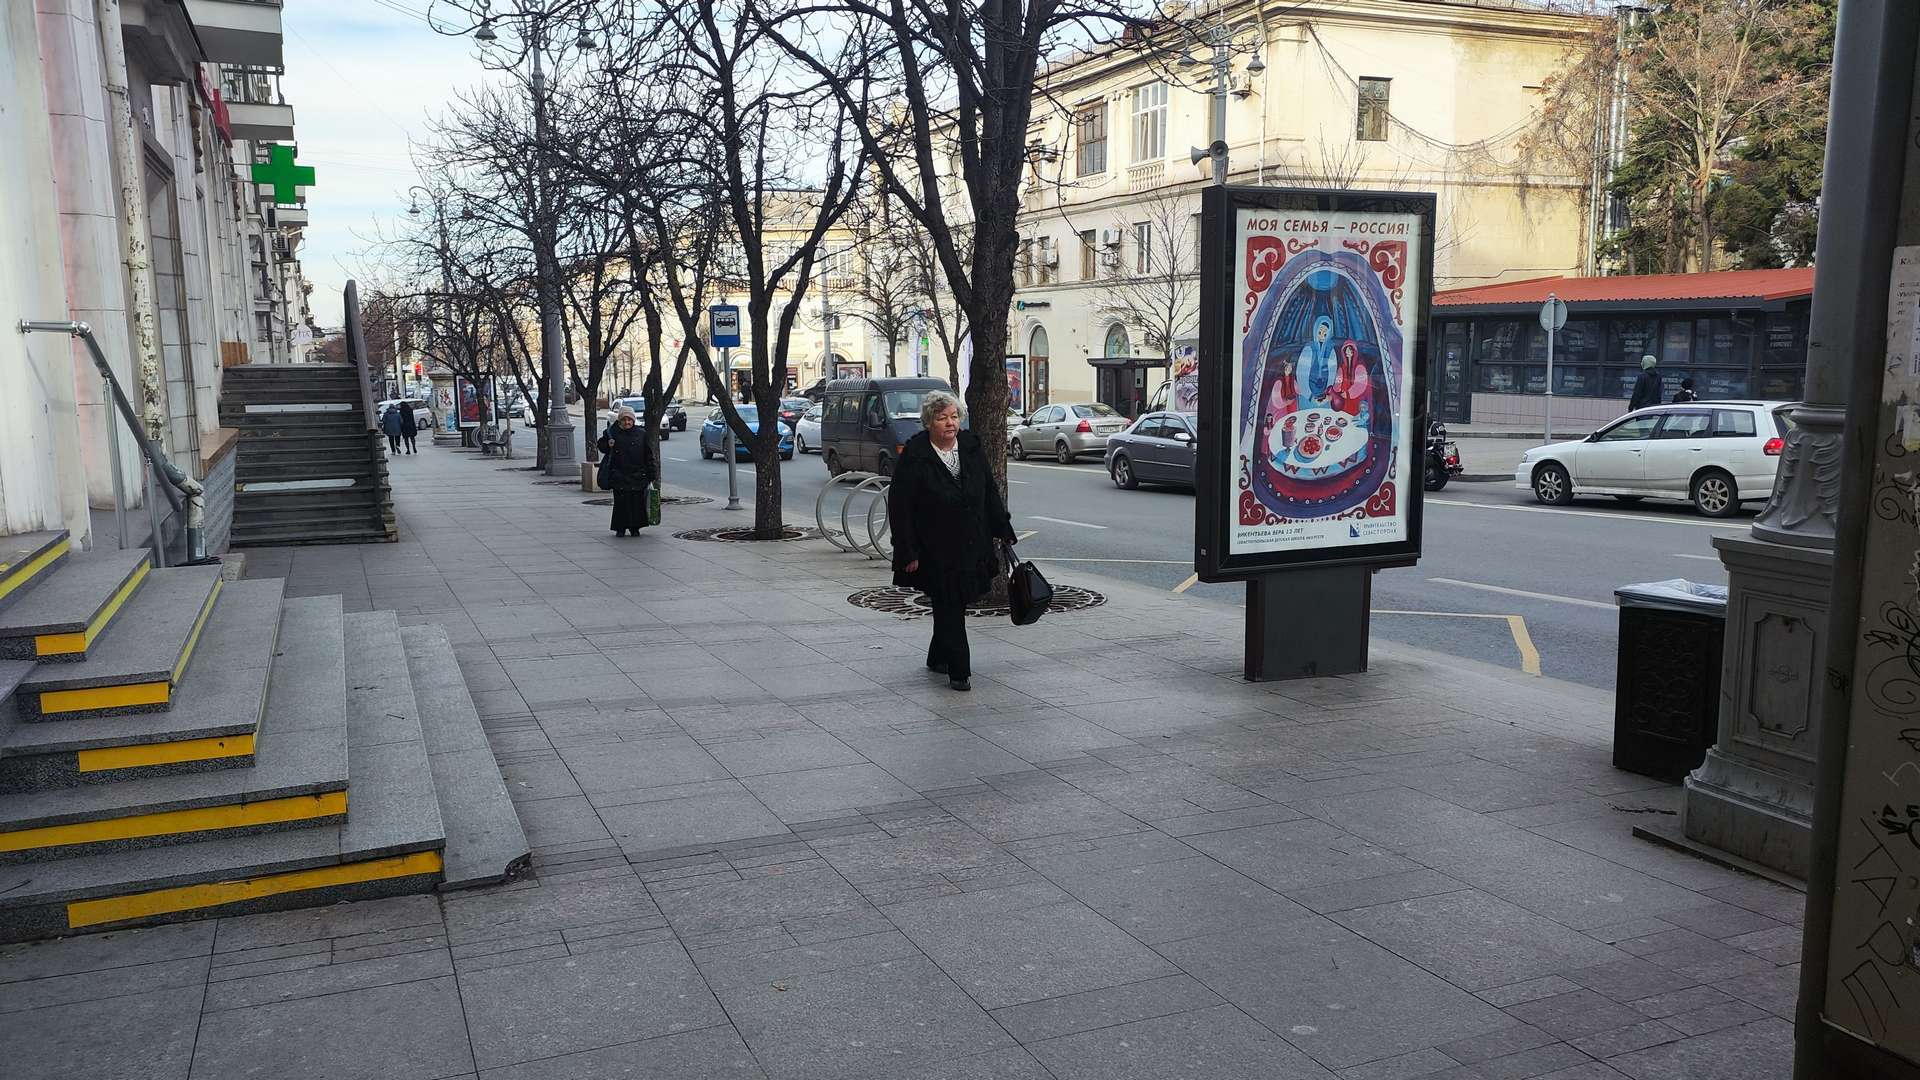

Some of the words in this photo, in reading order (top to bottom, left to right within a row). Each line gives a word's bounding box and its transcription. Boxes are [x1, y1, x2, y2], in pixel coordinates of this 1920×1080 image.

[1247, 217, 1279, 231] МОЯ
[1283, 218, 1329, 233] СЕМЬЯ
[1350, 221, 1410, 235] РОССИЯ!
